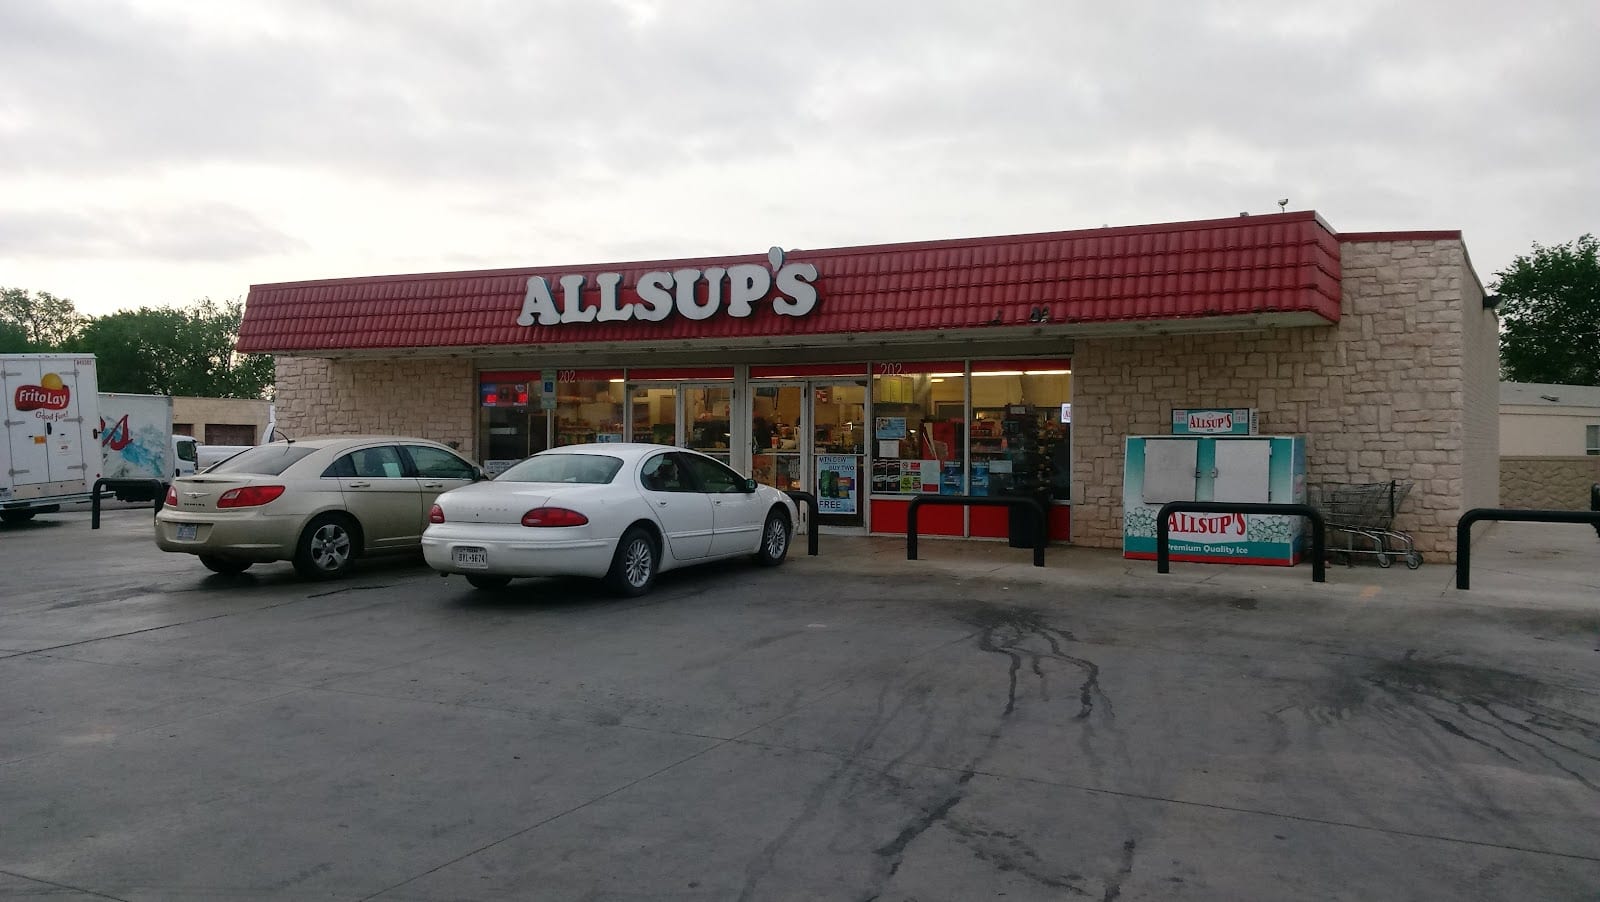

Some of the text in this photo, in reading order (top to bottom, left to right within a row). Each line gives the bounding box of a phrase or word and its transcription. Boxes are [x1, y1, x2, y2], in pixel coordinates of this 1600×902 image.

[516, 246, 818, 326] ALLSUP'S
[559, 370, 576, 383] 202
[35, 411, 54, 420] Good
[1189, 414, 1232, 429] ALLSUP'S
[819, 500, 841, 509] FREE
[1168, 512, 1246, 536] ALLSUP'S
[1203, 544, 1235, 554] Quality
[1236, 546, 1248, 554] Ice
